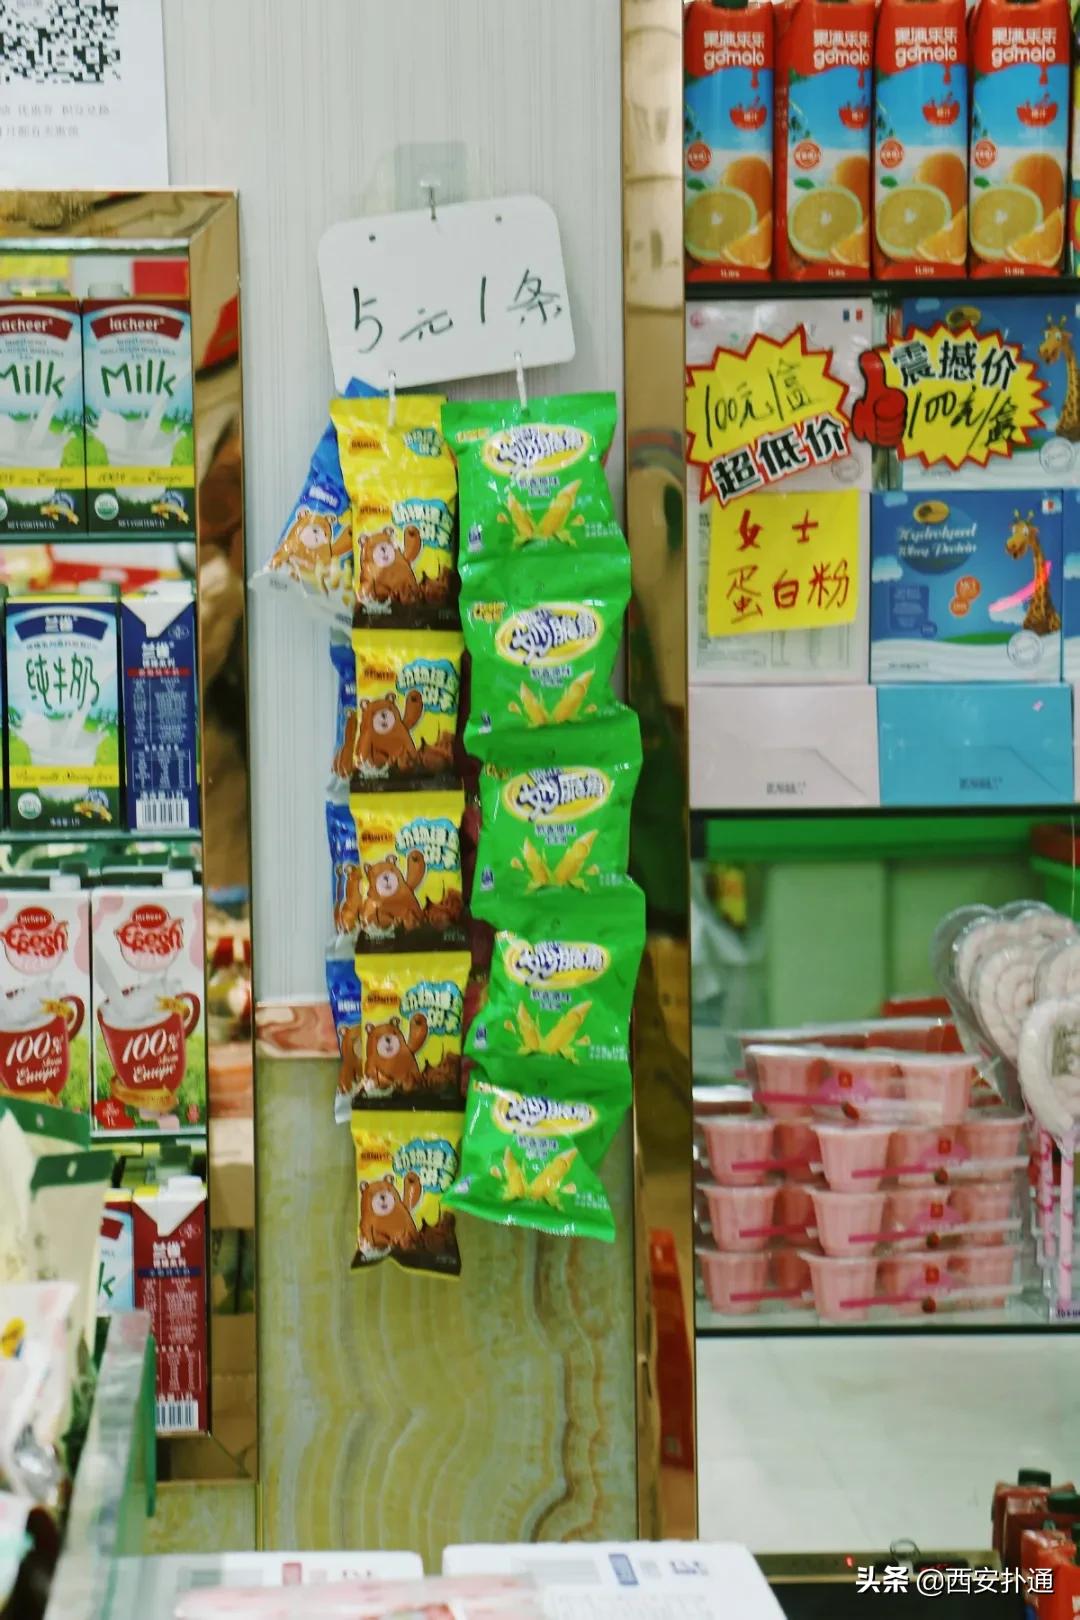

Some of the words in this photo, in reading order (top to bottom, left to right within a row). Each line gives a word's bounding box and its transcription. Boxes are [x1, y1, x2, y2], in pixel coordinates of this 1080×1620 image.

[704, 48, 764, 69] gomolo
[895, 45, 957, 67] gomolo
[992, 45, 1056, 67] gomolo
[353, 269, 561, 353] 5元1条
[101, 360, 176, 397] Milk
[893, 341, 1016, 391] 震撼价
[713, 418, 845, 499] 超低价
[726, 558, 850, 624] 蛋白粉
[27, 653, 99, 710] 纯牛奶
